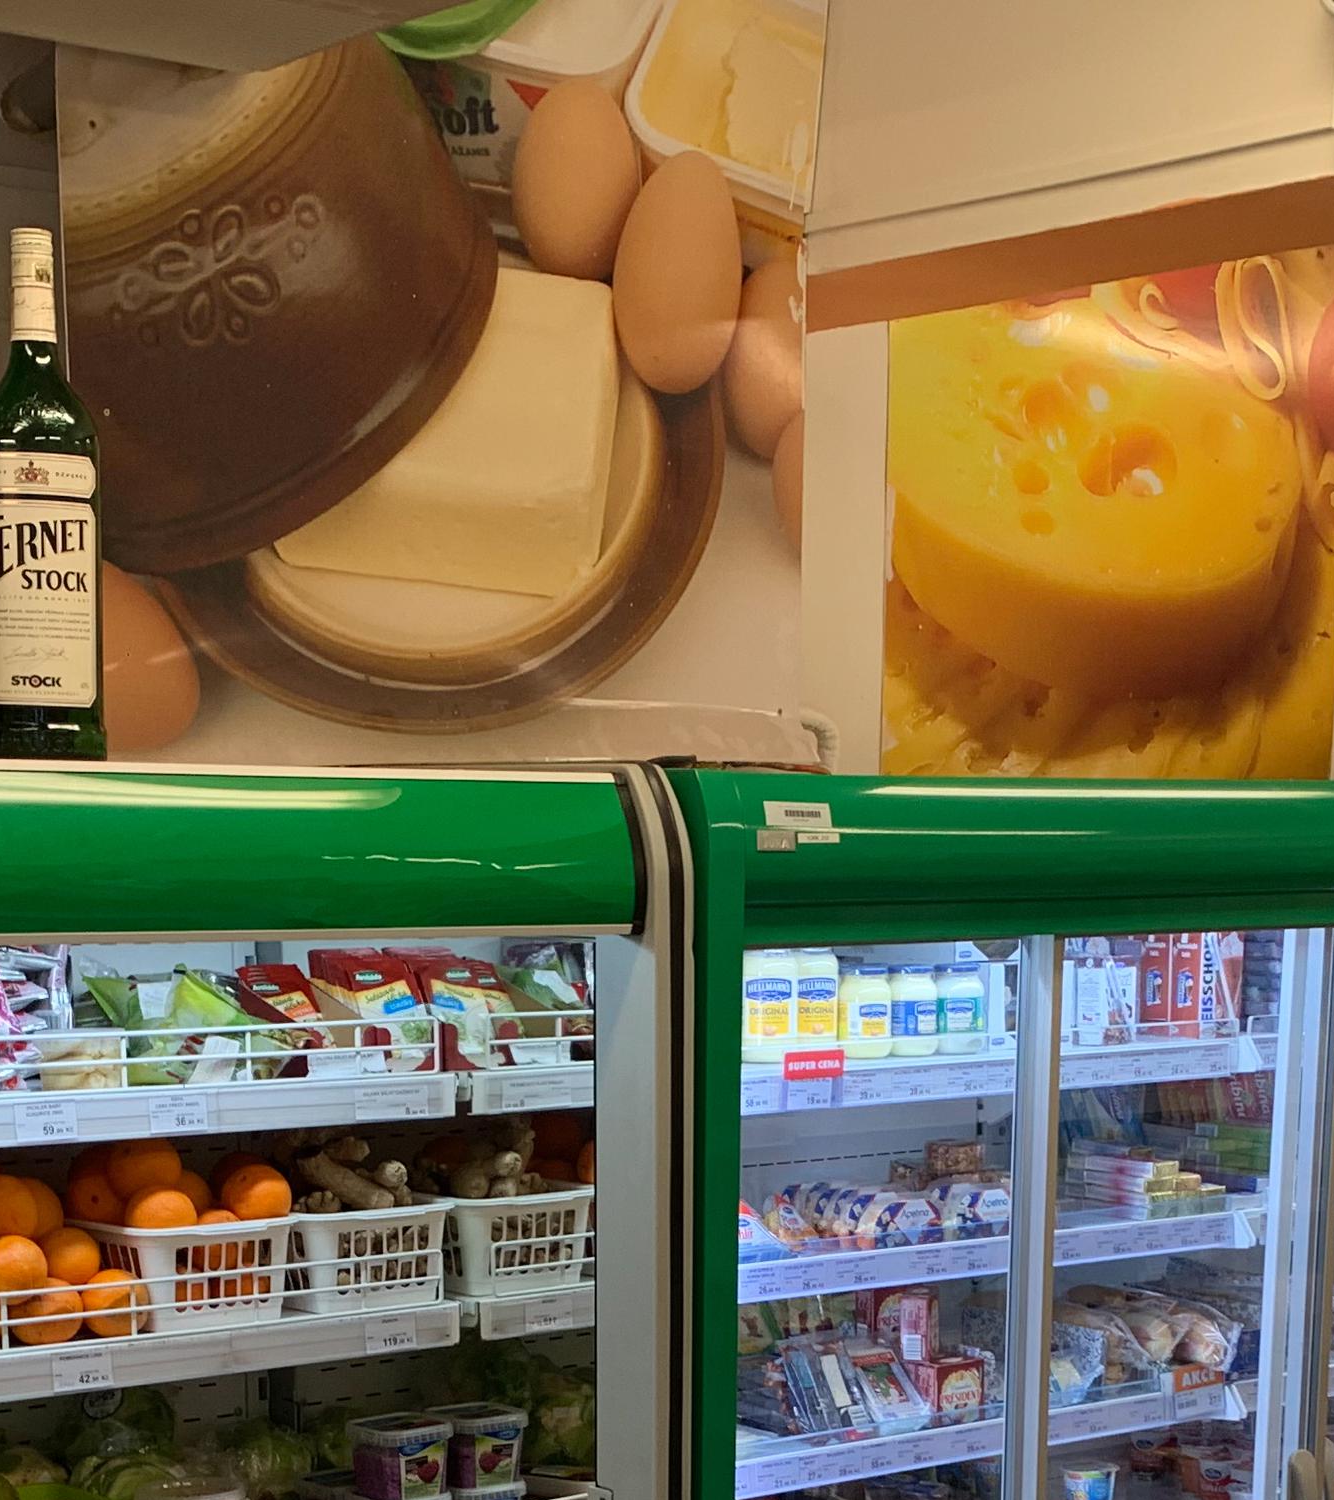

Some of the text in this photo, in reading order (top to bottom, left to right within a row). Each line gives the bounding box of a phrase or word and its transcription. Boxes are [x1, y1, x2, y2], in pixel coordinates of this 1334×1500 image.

[21, 569, 89, 593] STOCK
[11, 674, 62, 689] STOCK
[750, 1006, 789, 1017] ORIGINAL
[787, 1058, 841, 1072] SUPER CENA
[1179, 1367, 1219, 1388] AKCE
